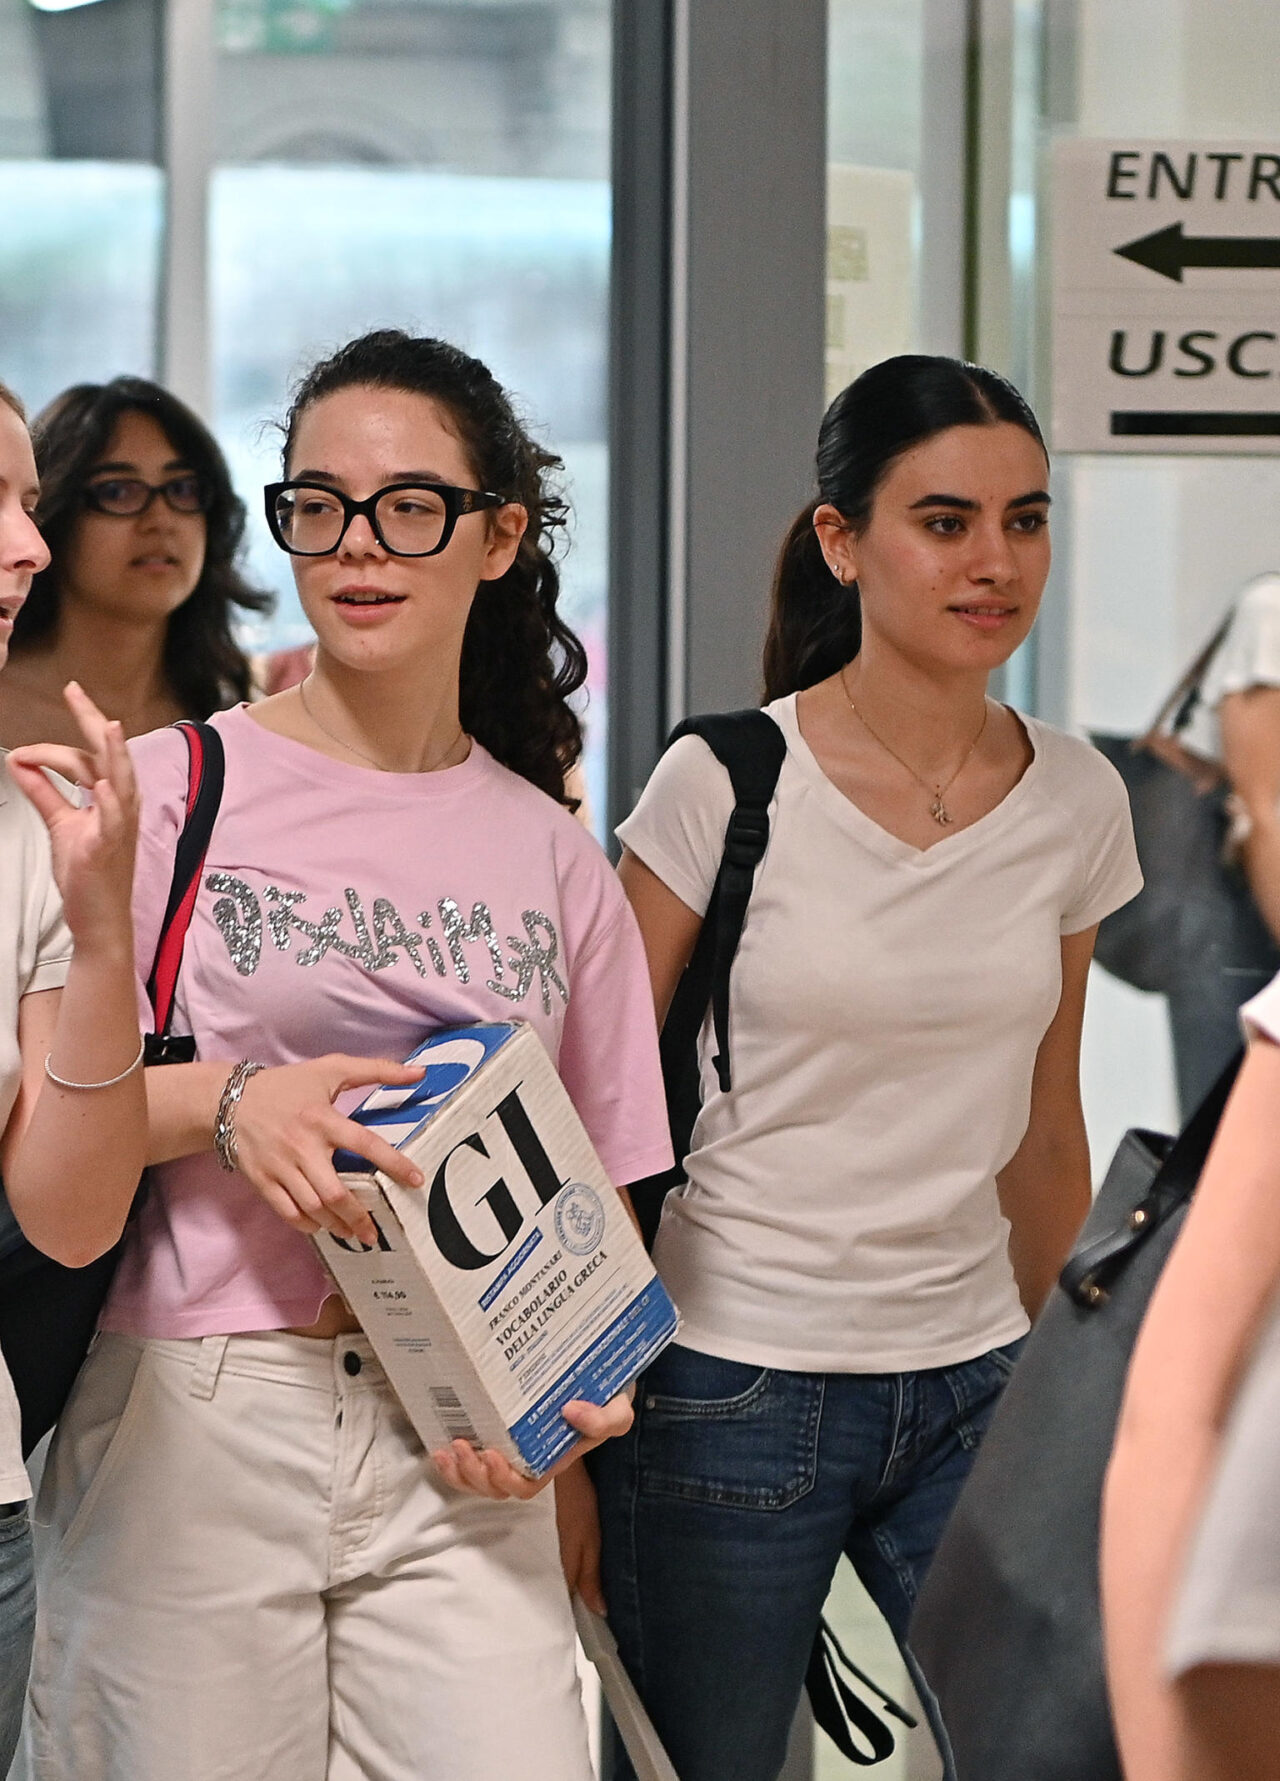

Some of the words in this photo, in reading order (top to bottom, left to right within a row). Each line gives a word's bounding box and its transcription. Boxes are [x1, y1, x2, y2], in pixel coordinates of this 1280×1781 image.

[1107, 151, 1280, 200] ENTR
[1109, 329, 1280, 379] USC
[427, 1080, 570, 1271] GI
[487, 1296, 520, 1331] FRANCO
[520, 1250, 564, 1297] MONTANARI
[494, 1269, 569, 1347] VOCABOLARIO
[503, 1324, 539, 1362] DELLA
[537, 1284, 576, 1328] LINGUA
[573, 1250, 608, 1289] GRECA
